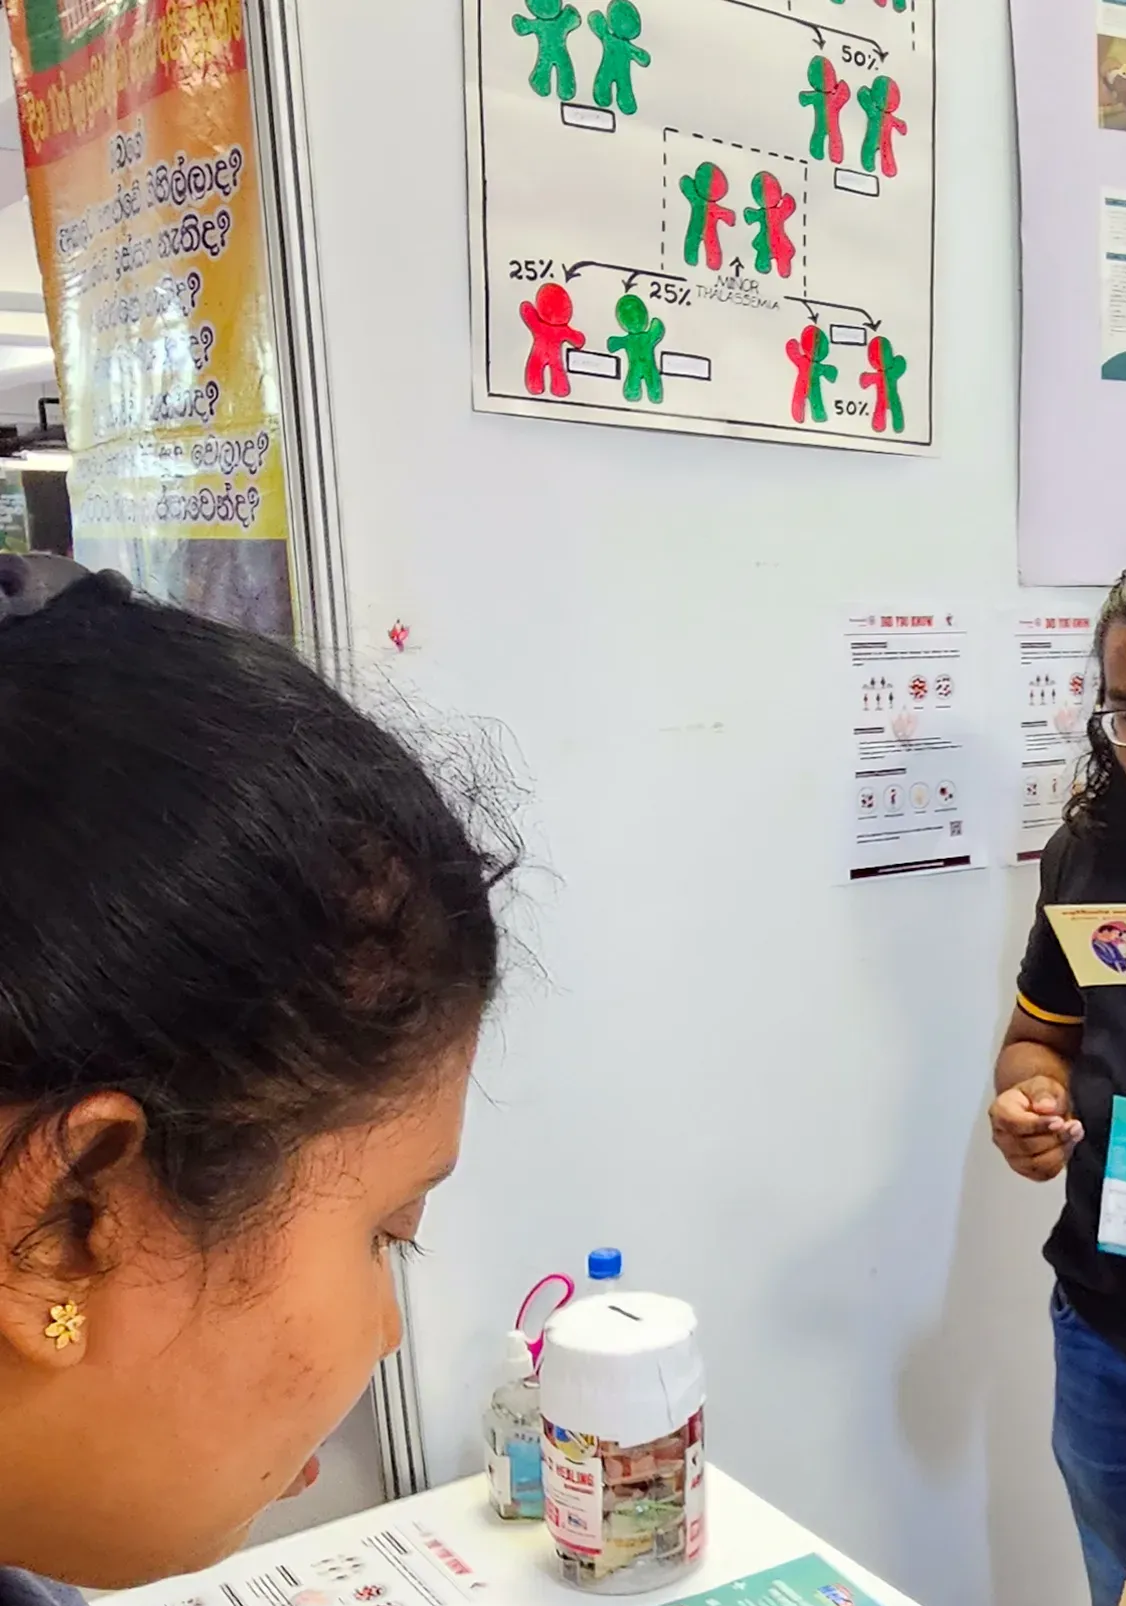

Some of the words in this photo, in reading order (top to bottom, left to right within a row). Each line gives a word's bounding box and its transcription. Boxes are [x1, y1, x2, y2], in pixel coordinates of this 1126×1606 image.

[840, 44, 880, 72] 50%
[509, 259, 554, 281] 25%
[649, 281, 692, 308] 25%
[714, 274, 760, 295] MINOR
[833, 400, 870, 417] 50%
